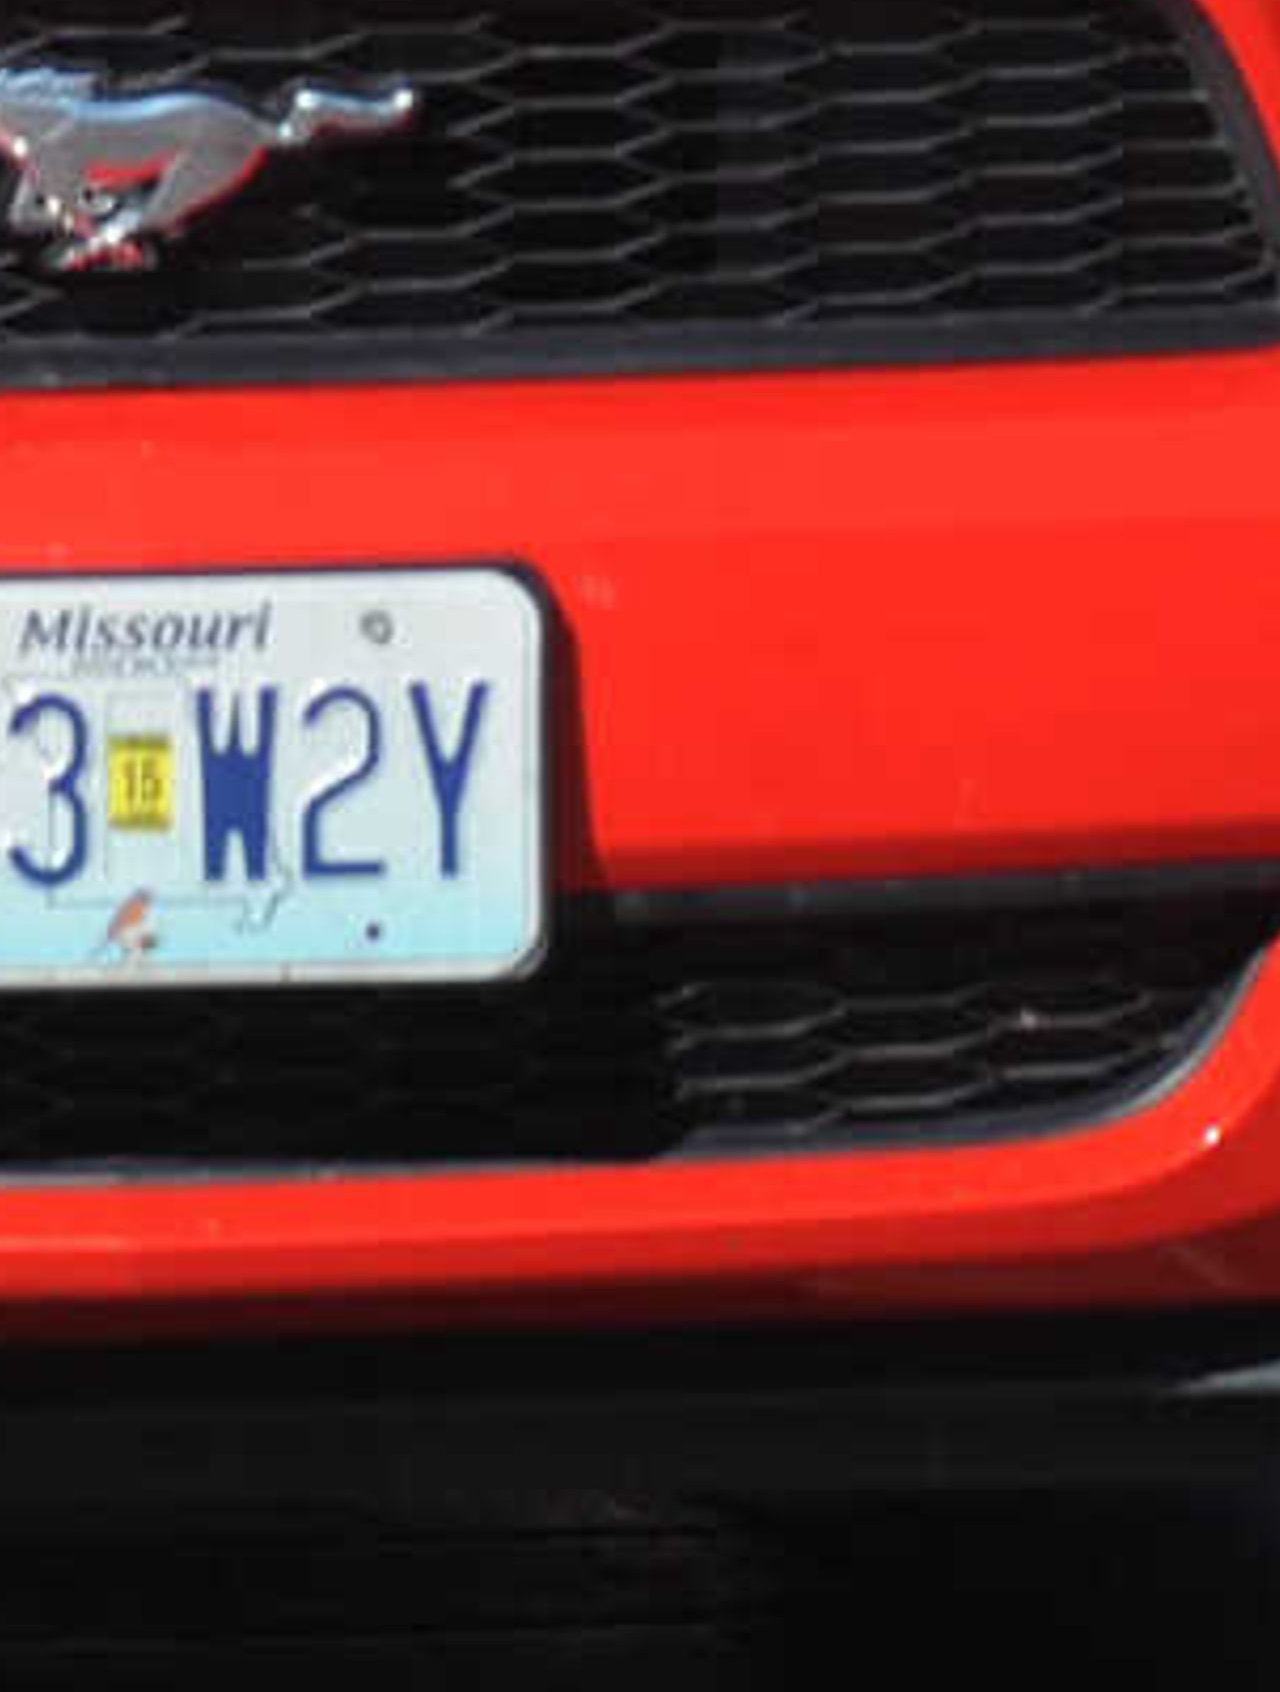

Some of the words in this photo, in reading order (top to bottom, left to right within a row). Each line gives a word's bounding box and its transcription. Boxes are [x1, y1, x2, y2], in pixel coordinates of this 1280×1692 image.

[19, 599, 273, 657] Missouri
[122, 755, 164, 807] 15
[196, 681, 489, 882] W2Y
